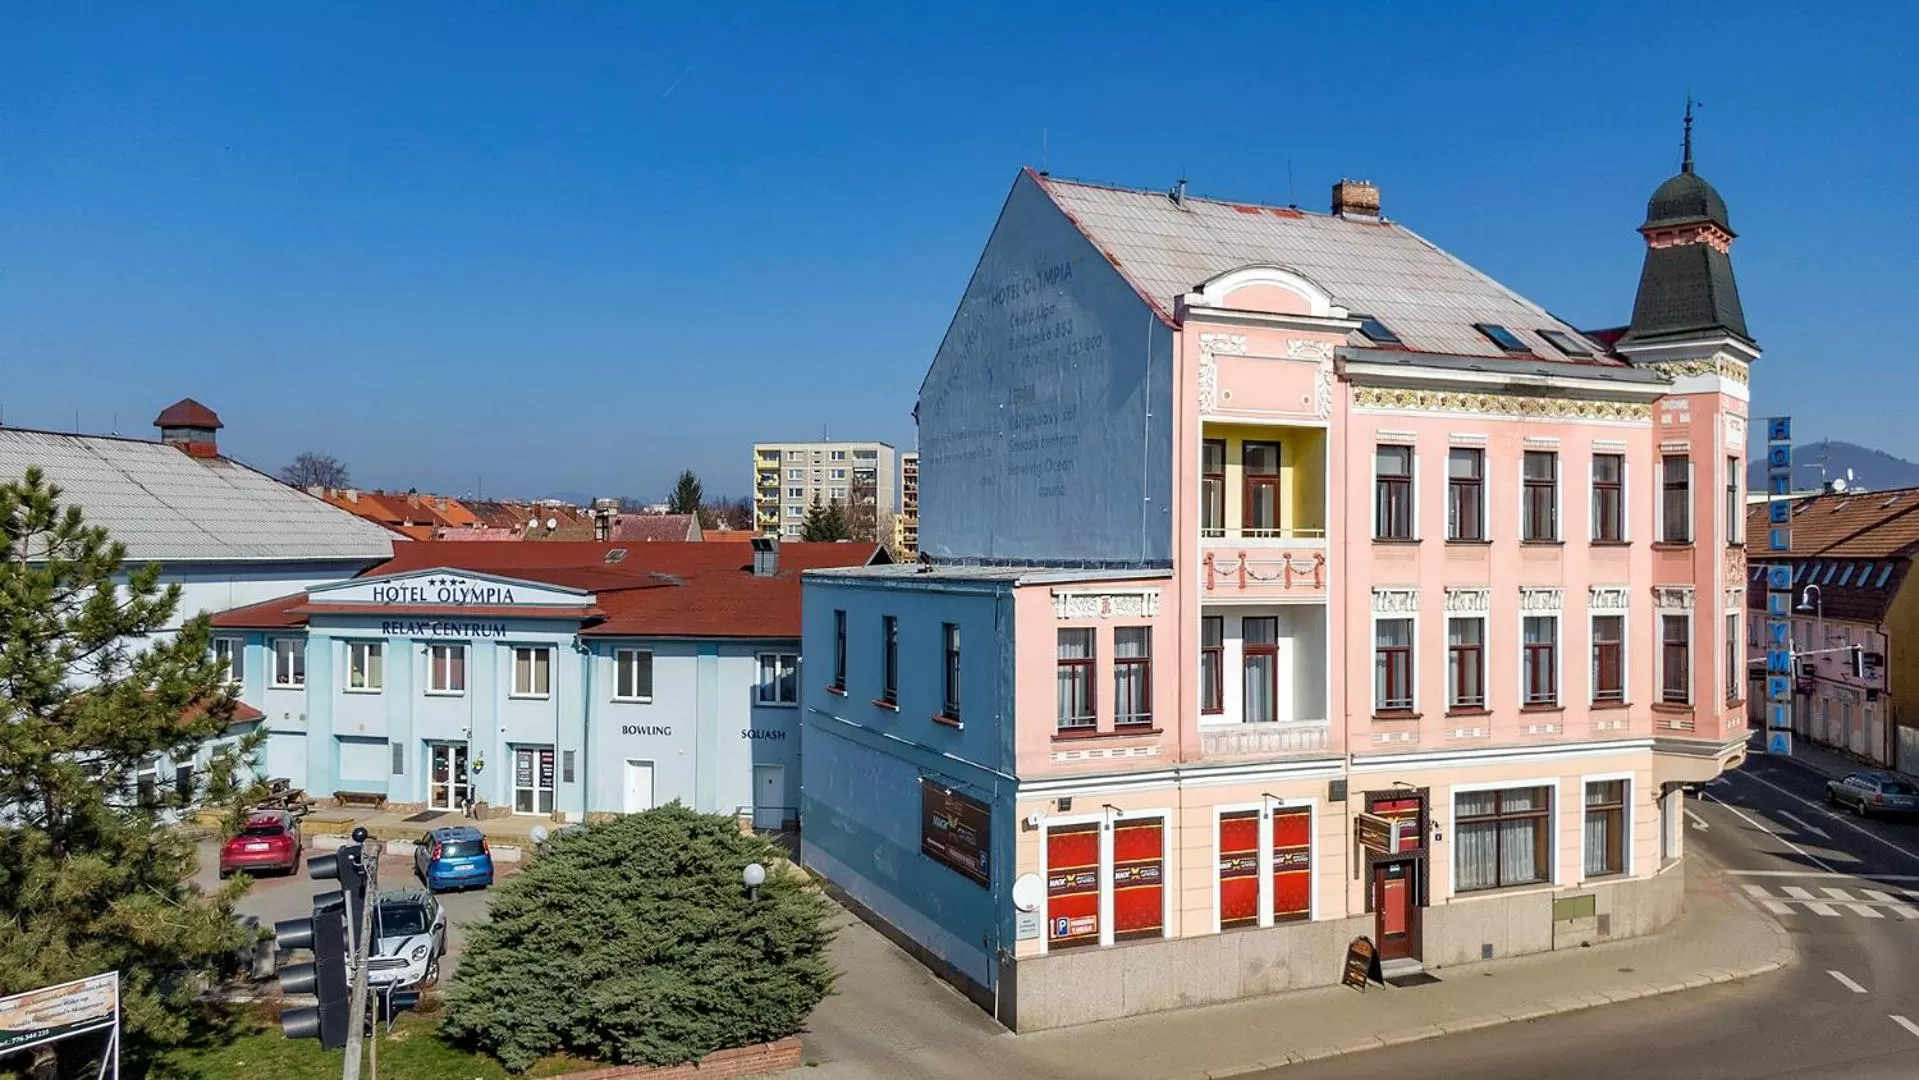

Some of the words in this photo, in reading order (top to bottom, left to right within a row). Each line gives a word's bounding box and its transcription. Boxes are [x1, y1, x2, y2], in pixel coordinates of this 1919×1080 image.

[1023, 261, 1073, 295] OLYMPIA
[1769, 418, 1791, 551] HOTEL
[373, 586, 427, 602] HOTEL
[437, 587, 515, 603] OLYMPIA
[382, 621, 425, 636] RELAX
[432, 622, 507, 637] CENTRUM
[1768, 567, 1790, 753] OLYMPIA
[622, 725, 672, 736] BOWLING
[741, 729, 786, 741] SQUASH
